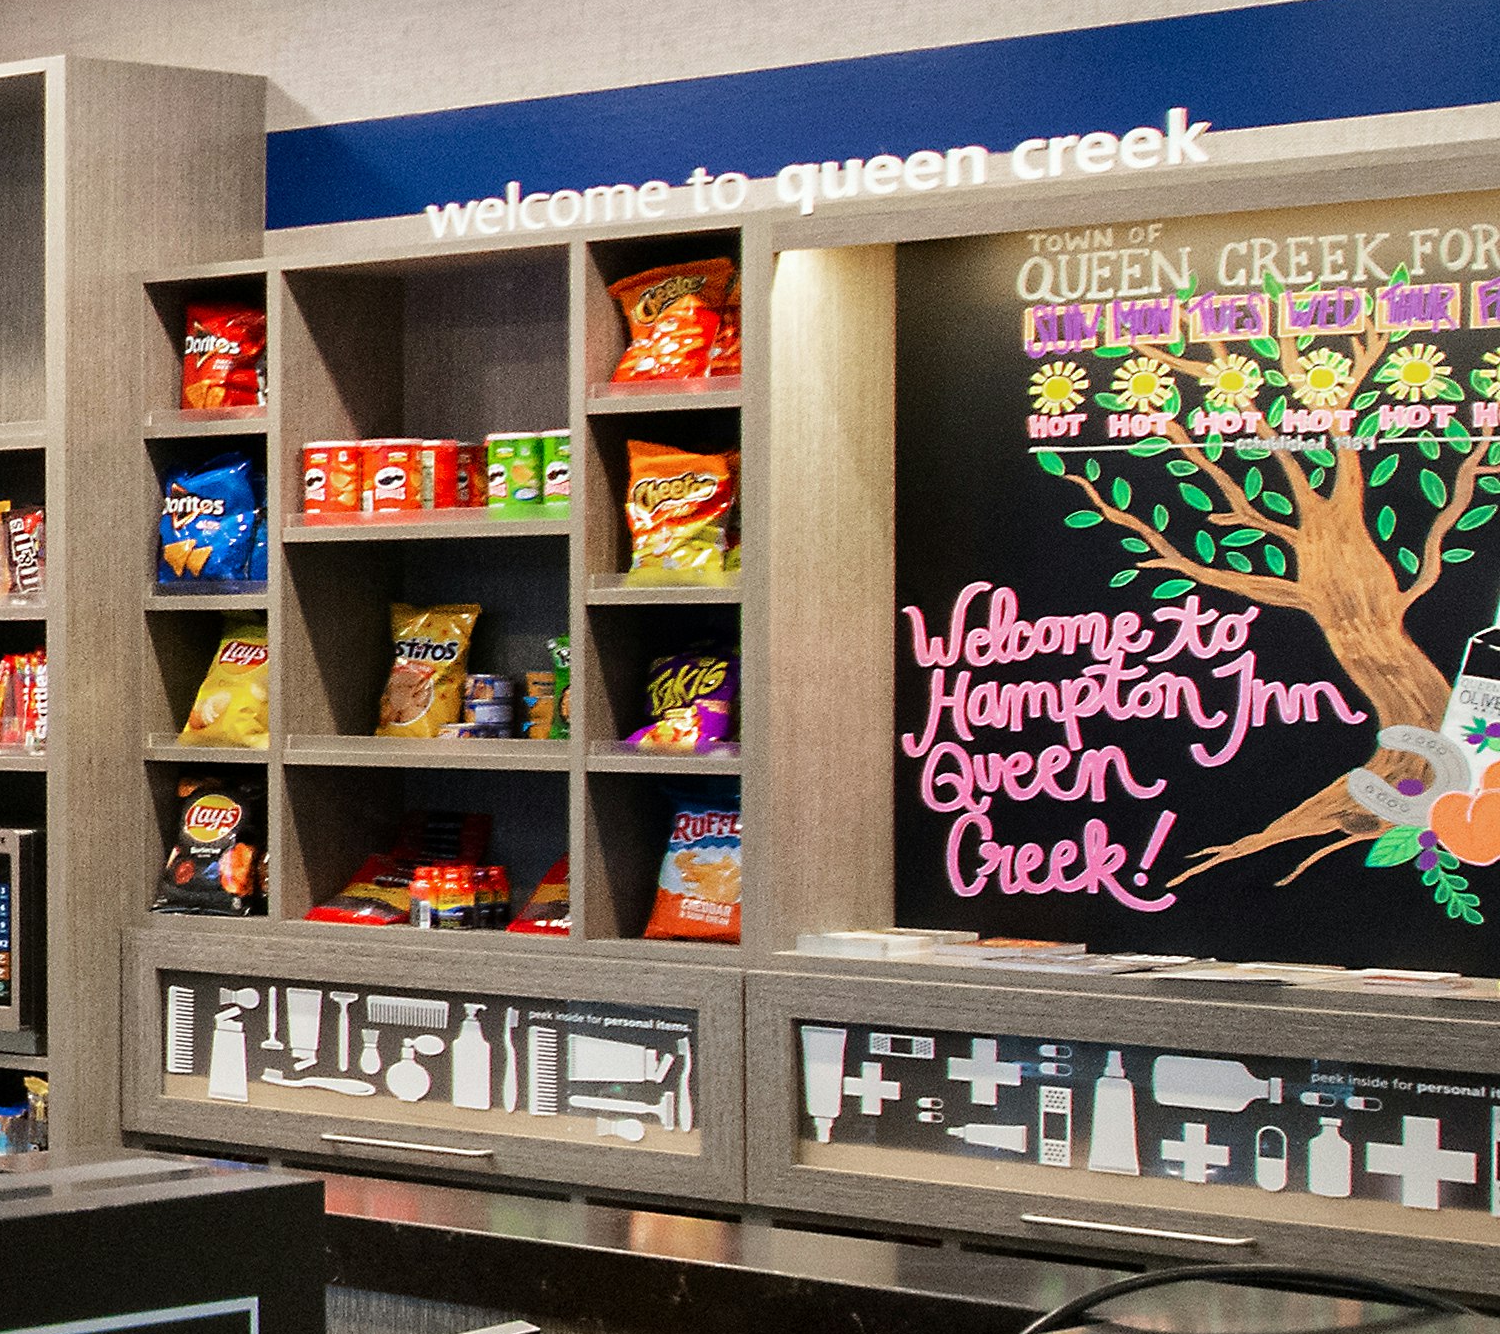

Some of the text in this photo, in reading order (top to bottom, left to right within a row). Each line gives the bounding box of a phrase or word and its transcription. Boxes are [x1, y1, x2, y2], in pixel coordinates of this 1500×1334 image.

[425, 106, 1212, 238] welcome to queen creek
[1016, 246, 1192, 302] QUEEN
[1217, 231, 1391, 287] CREEK
[1027, 222, 1163, 253] TOWN OF
[1186, 290, 1265, 337] TUES
[1286, 285, 1362, 330] WED
[1028, 413, 1088, 439] HOT
[1107, 413, 1174, 439] HOT
[1194, 411, 1264, 436] HOT
[1282, 408, 1358, 434] HOT
[1379, 404, 1457, 431] HOT
[902, 581, 1261, 667] Welcome to
[902, 650, 1367, 767] Hampton Inn
[921, 741, 1167, 813] Queen
[947, 809, 1177, 912] Creek!
[604, 1017, 654, 1029] personal
[1311, 1073, 1345, 1084] peek
[1348, 1075, 1389, 1089] inside
[1392, 1078, 1413, 1091] for
[1417, 1082, 1486, 1097] personal
